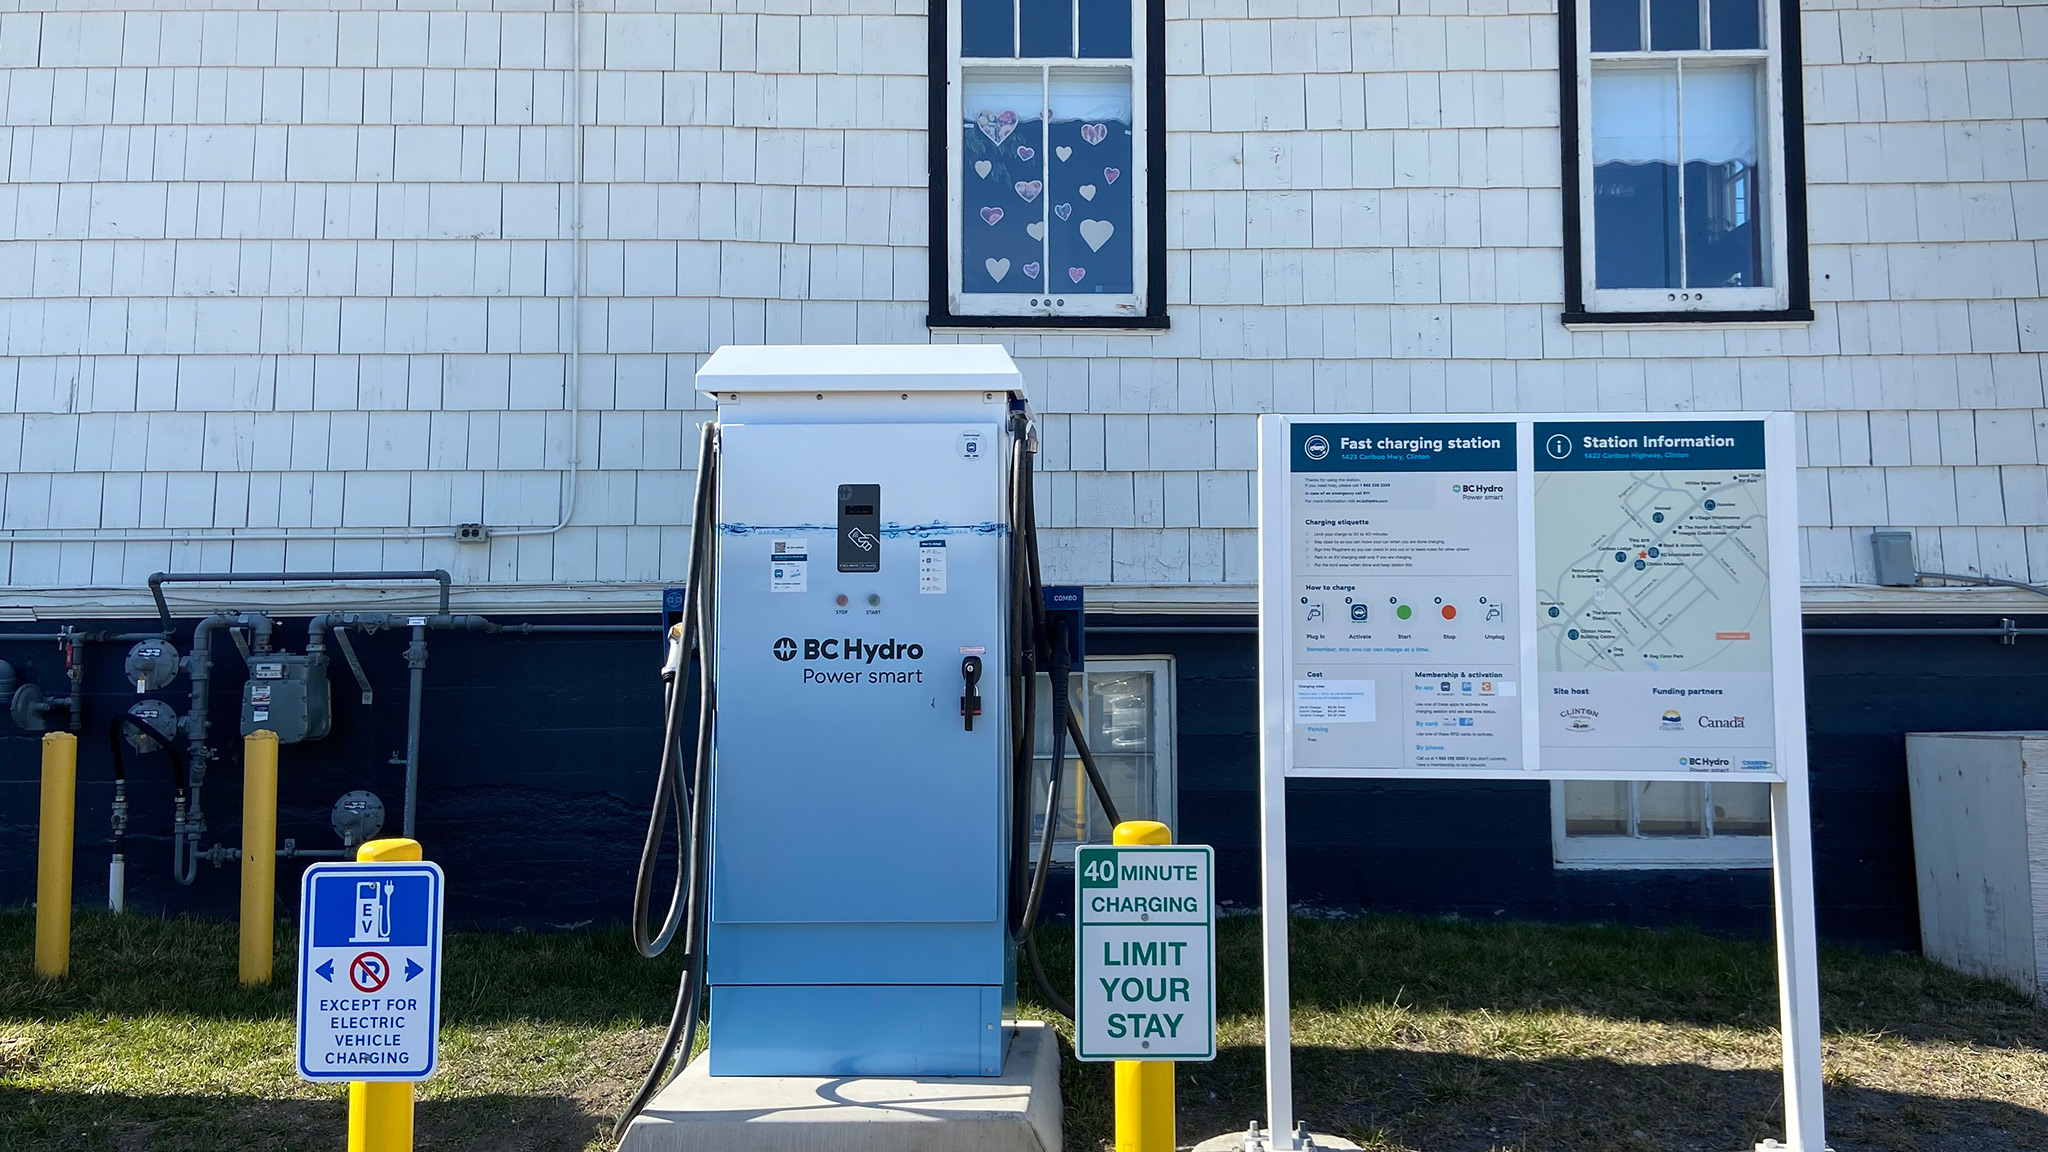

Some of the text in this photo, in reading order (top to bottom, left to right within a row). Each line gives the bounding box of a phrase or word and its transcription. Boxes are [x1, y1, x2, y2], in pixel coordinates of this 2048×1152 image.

[1340, 436, 1501, 452] Fast charging station
[1583, 434, 1735, 448] Station Information
[1387, 453, 1404, 461] Hwy,
[1462, 484, 1504, 494] BC Hydro
[1305, 519, 1336, 527] Charging
[1332, 584, 1356, 592] charge
[804, 638, 924, 665] BC Hydro
[803, 668, 923, 684] Power smart
[1652, 688, 1723, 696] Funding partners
[1560, 708, 1599, 718] CLINTON
[1698, 716, 1745, 728] Canada
[1702, 758, 1729, 767] Hydro
[1084, 860, 1198, 882] 40 MINUTE
[1091, 896, 1198, 913] CHARGING
[1104, 942, 1188, 966] LIMIT
[1099, 977, 1190, 1002] YOUR
[320, 999, 417, 1011] EXCEPT FOR
[331, 1017, 405, 1029] ELECTRIC
[1107, 1013, 1184, 1038] STAY
[335, 1034, 401, 1046] VEHICLE
[325, 1052, 410, 1065] CHARGING
